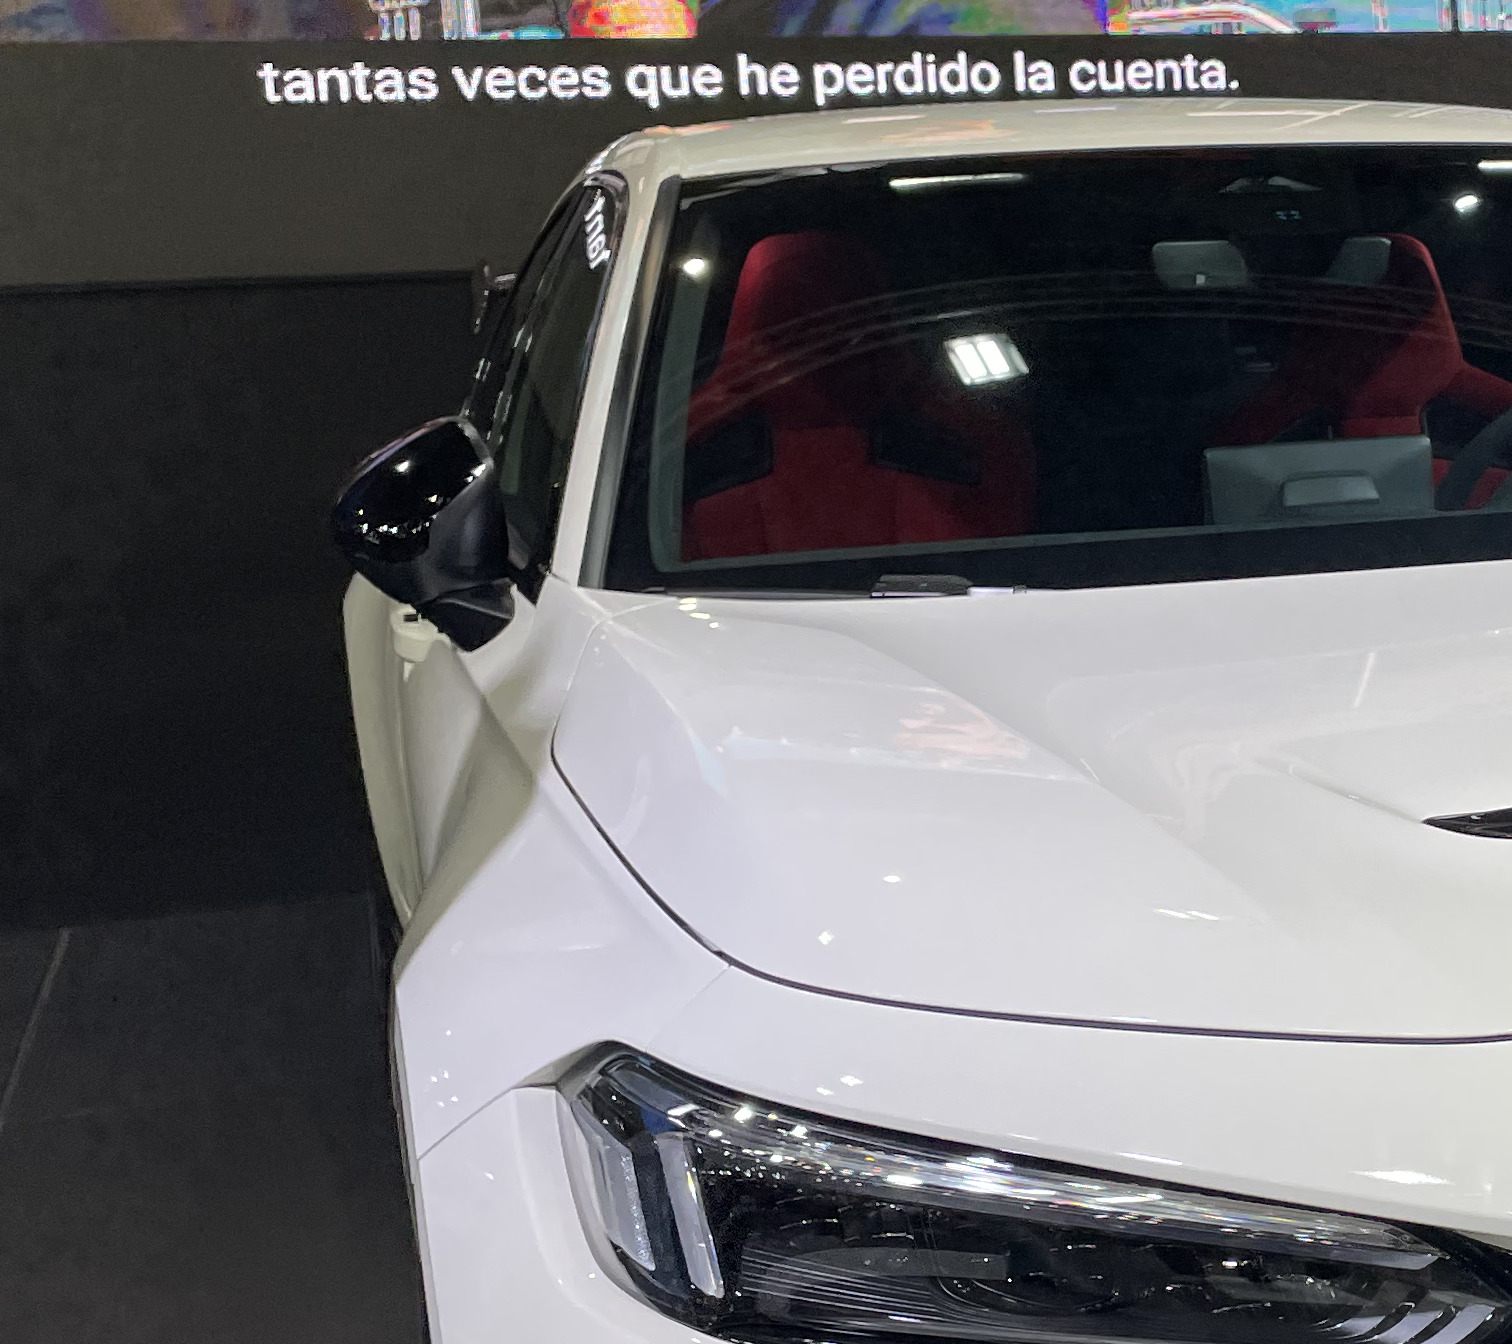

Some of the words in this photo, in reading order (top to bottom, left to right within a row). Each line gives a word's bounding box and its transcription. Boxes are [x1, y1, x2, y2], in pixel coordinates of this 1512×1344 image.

[257, 61, 440, 104] tantas
[450, 62, 612, 102] veces
[625, 62, 725, 110] que
[736, 51, 800, 98] he
[812, 51, 1002, 106] perdido
[1012, 50, 1057, 94] la
[1069, 53, 1240, 94] cuenta.
